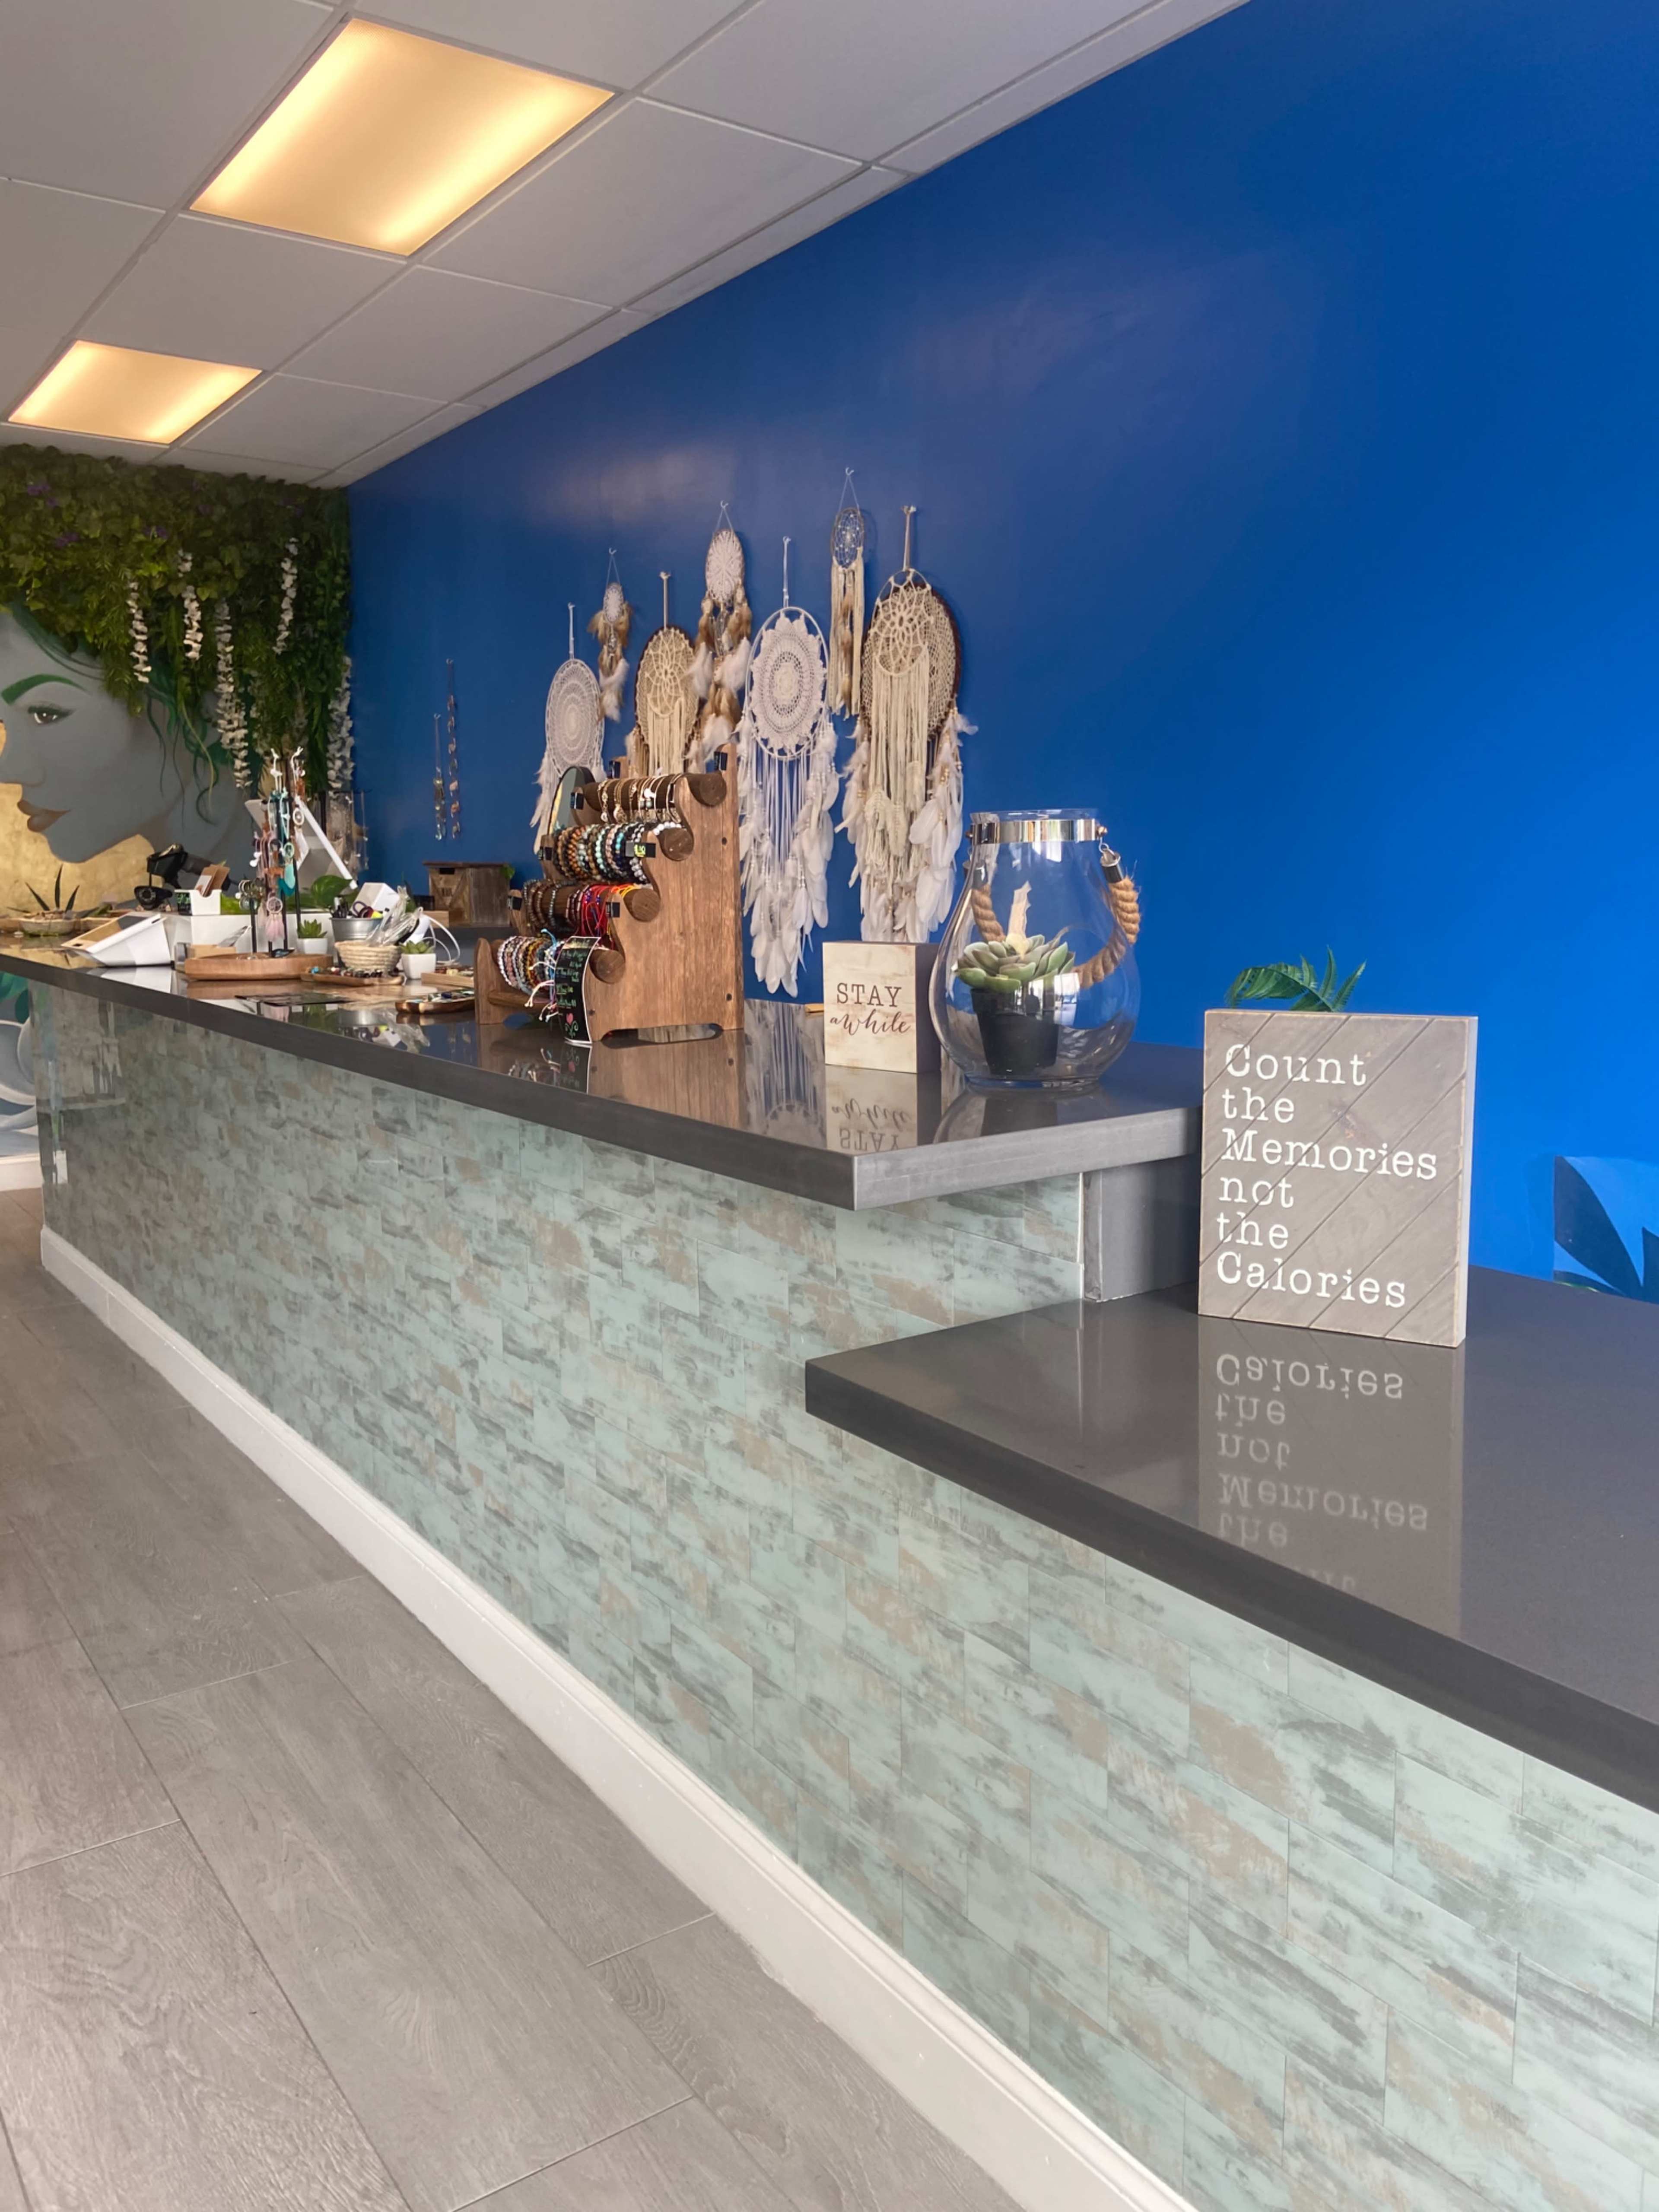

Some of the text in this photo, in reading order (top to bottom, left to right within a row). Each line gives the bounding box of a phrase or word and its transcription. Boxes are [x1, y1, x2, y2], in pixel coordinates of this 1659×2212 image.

[836, 982, 902, 1007] STAY
[830, 1009, 911, 1036] awhile
[1225, 1044, 1367, 1087] Count
[1222, 1087, 1295, 1123] the
[1221, 1128, 1438, 1181] Memories
[1218, 1176, 1294, 1208] not
[1216, 1212, 1289, 1249] the
[1217, 1251, 1406, 1309] Calories
